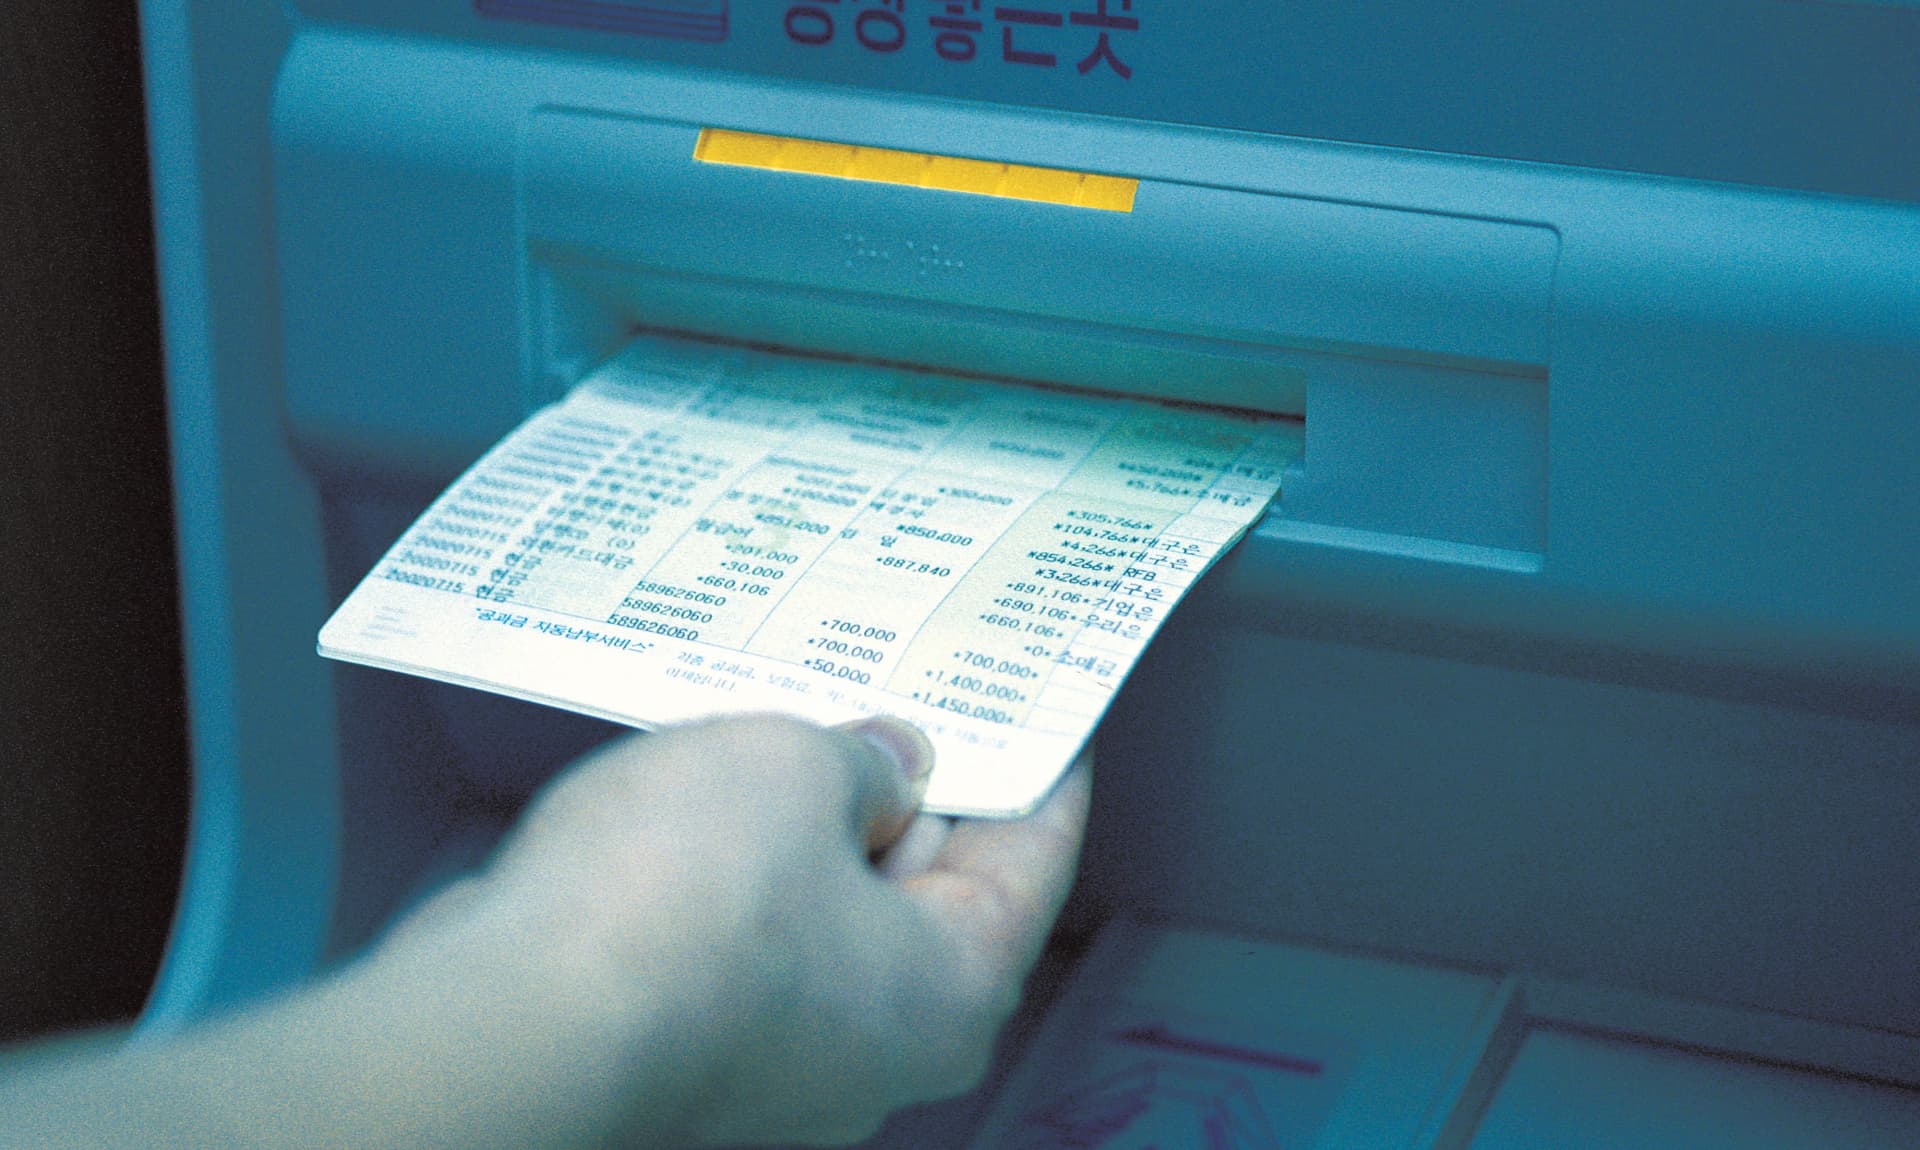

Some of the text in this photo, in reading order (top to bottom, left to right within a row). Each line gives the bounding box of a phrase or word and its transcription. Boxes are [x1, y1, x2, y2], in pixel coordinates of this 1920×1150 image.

[1122, 567, 1157, 582] RFB
[621, 596, 714, 625] 589626060
[1092, 597, 1154, 622] 기업은
[606, 613, 700, 642] 589626060
[1080, 612, 1142, 640] 우리은
